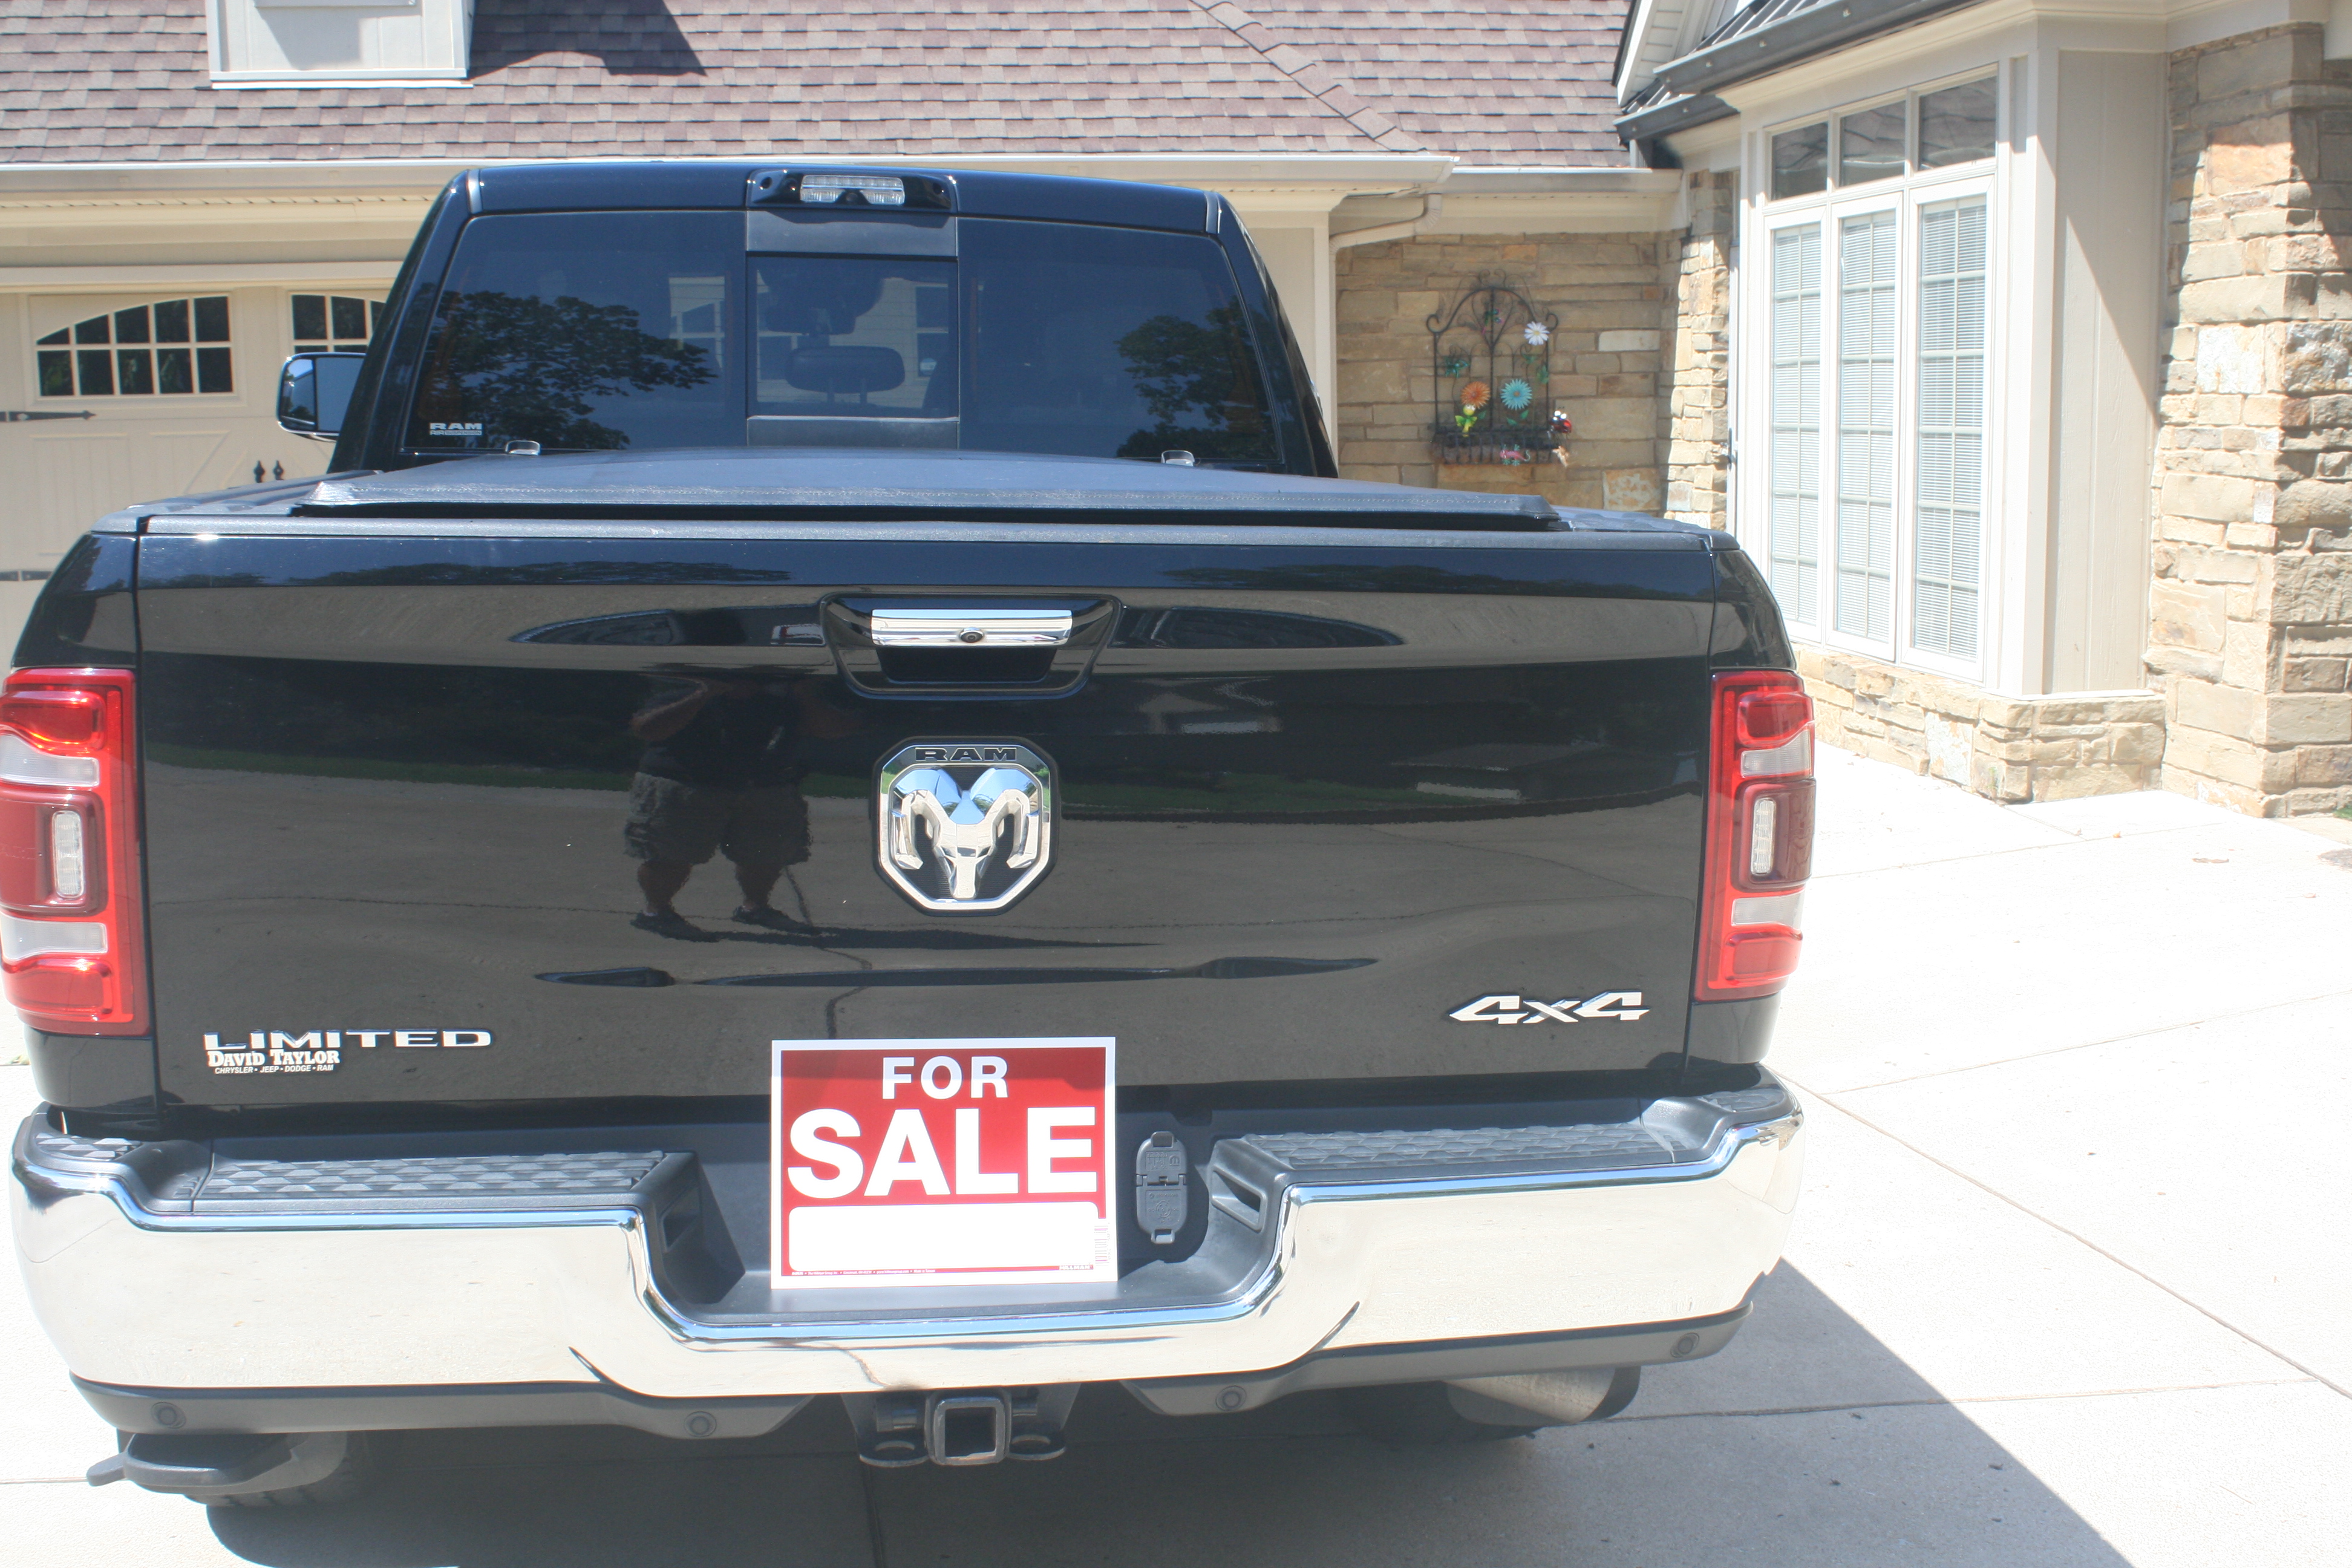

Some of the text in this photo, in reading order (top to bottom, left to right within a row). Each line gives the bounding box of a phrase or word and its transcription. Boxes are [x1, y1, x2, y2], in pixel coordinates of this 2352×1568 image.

[915, 747, 1017, 762] RAM
[1448, 990, 1650, 1025] 4x4
[202, 1028, 492, 1050] LIMITED
[207, 1048, 341, 1067] DAVID TAYLOR
[881, 1056, 1008, 1100] FOR
[787, 1106, 1098, 1199] SALE
